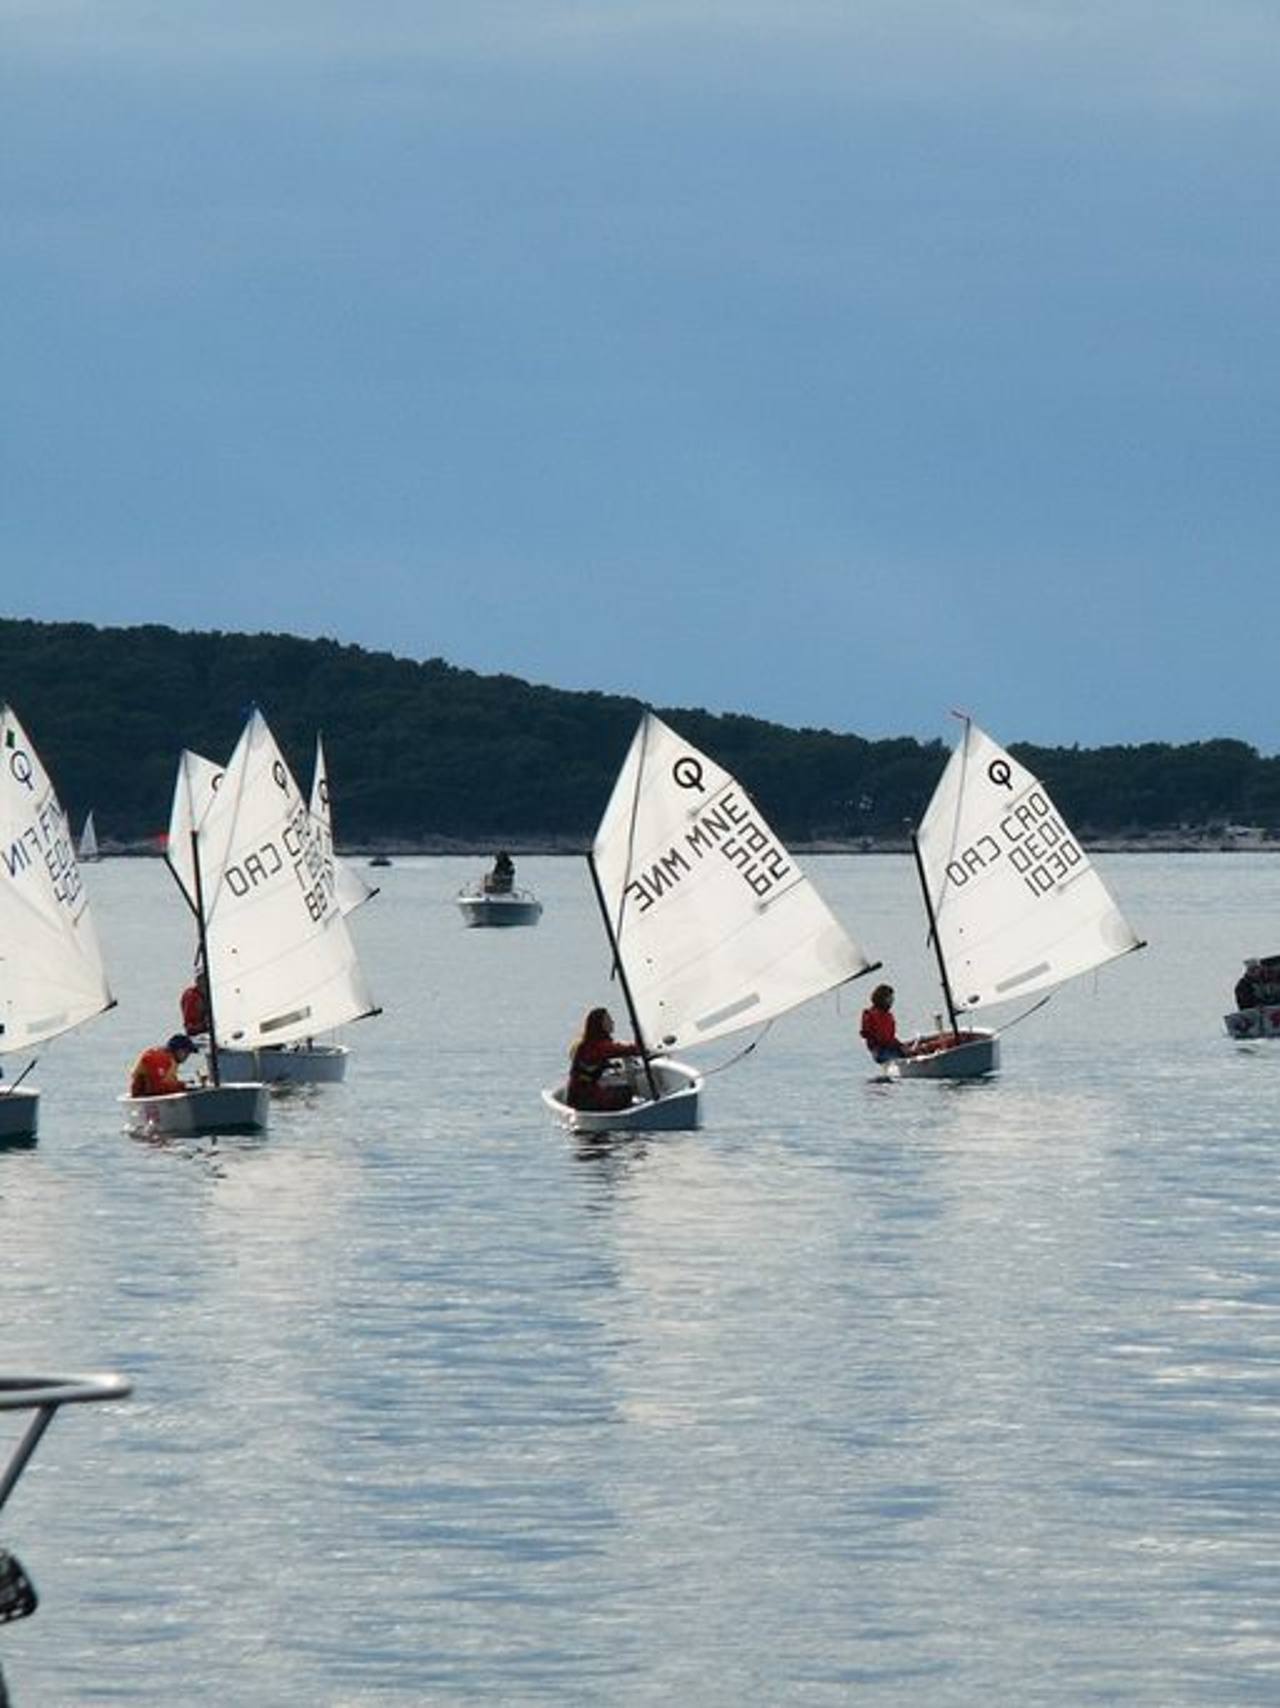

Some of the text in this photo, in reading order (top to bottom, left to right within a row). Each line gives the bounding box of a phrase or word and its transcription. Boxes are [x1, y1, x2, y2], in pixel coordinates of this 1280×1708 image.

[685, 792, 749, 858] MNE
[743, 848, 790, 896] 62
[1024, 840, 1082, 897] 1030
